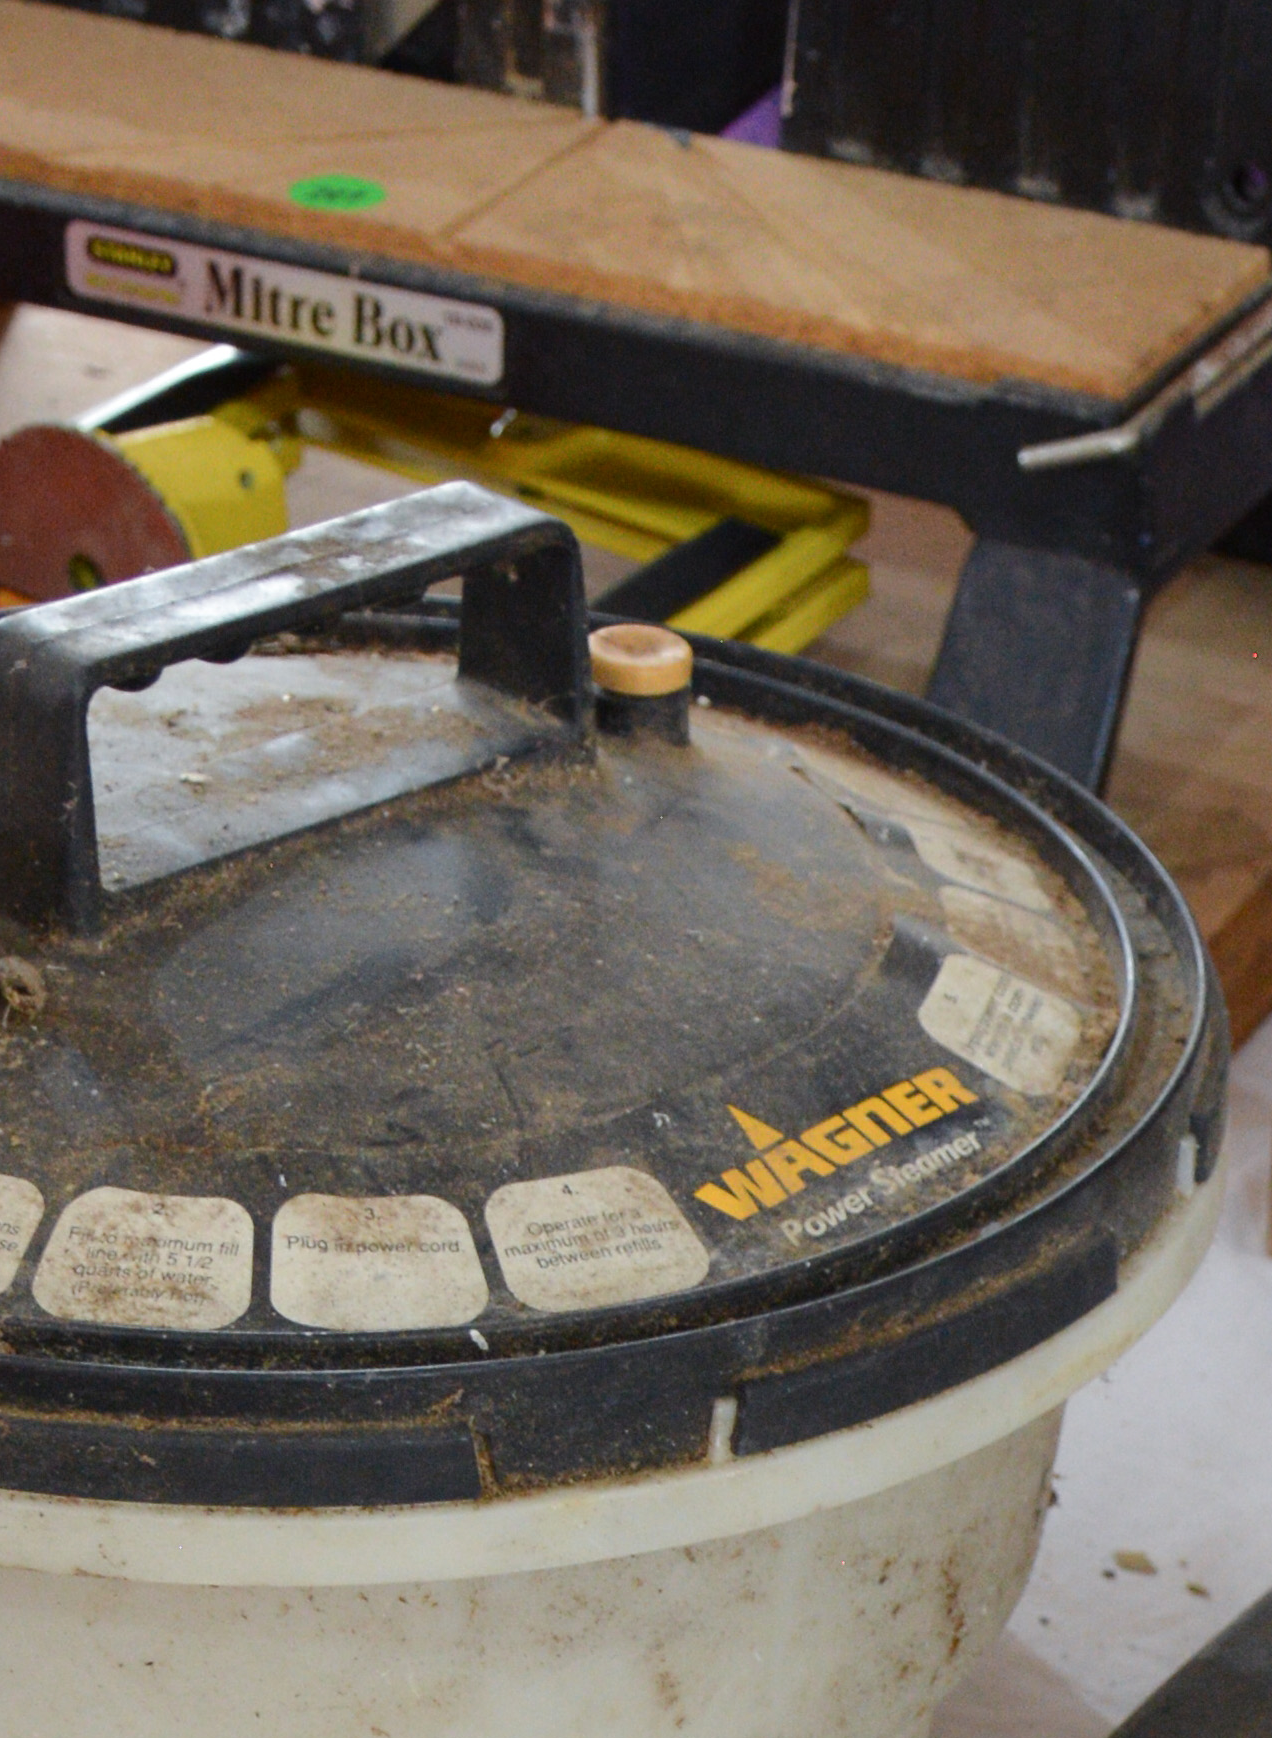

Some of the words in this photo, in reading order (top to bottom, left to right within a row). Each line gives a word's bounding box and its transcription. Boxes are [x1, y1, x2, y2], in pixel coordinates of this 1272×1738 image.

[205, 259, 336, 337] Mitre
[353, 292, 443, 361] Box
[693, 1066, 979, 1221] WAGNER
[528, 1213, 598, 1236] Operate
[780, 1188, 874, 1246] Power
[287, 1235, 328, 1253] Plug
[356, 1241, 412, 1256] power
[504, 1234, 590, 1258] maximum
[166, 1252, 178, 1266] 5
[536, 1247, 612, 1269] between
